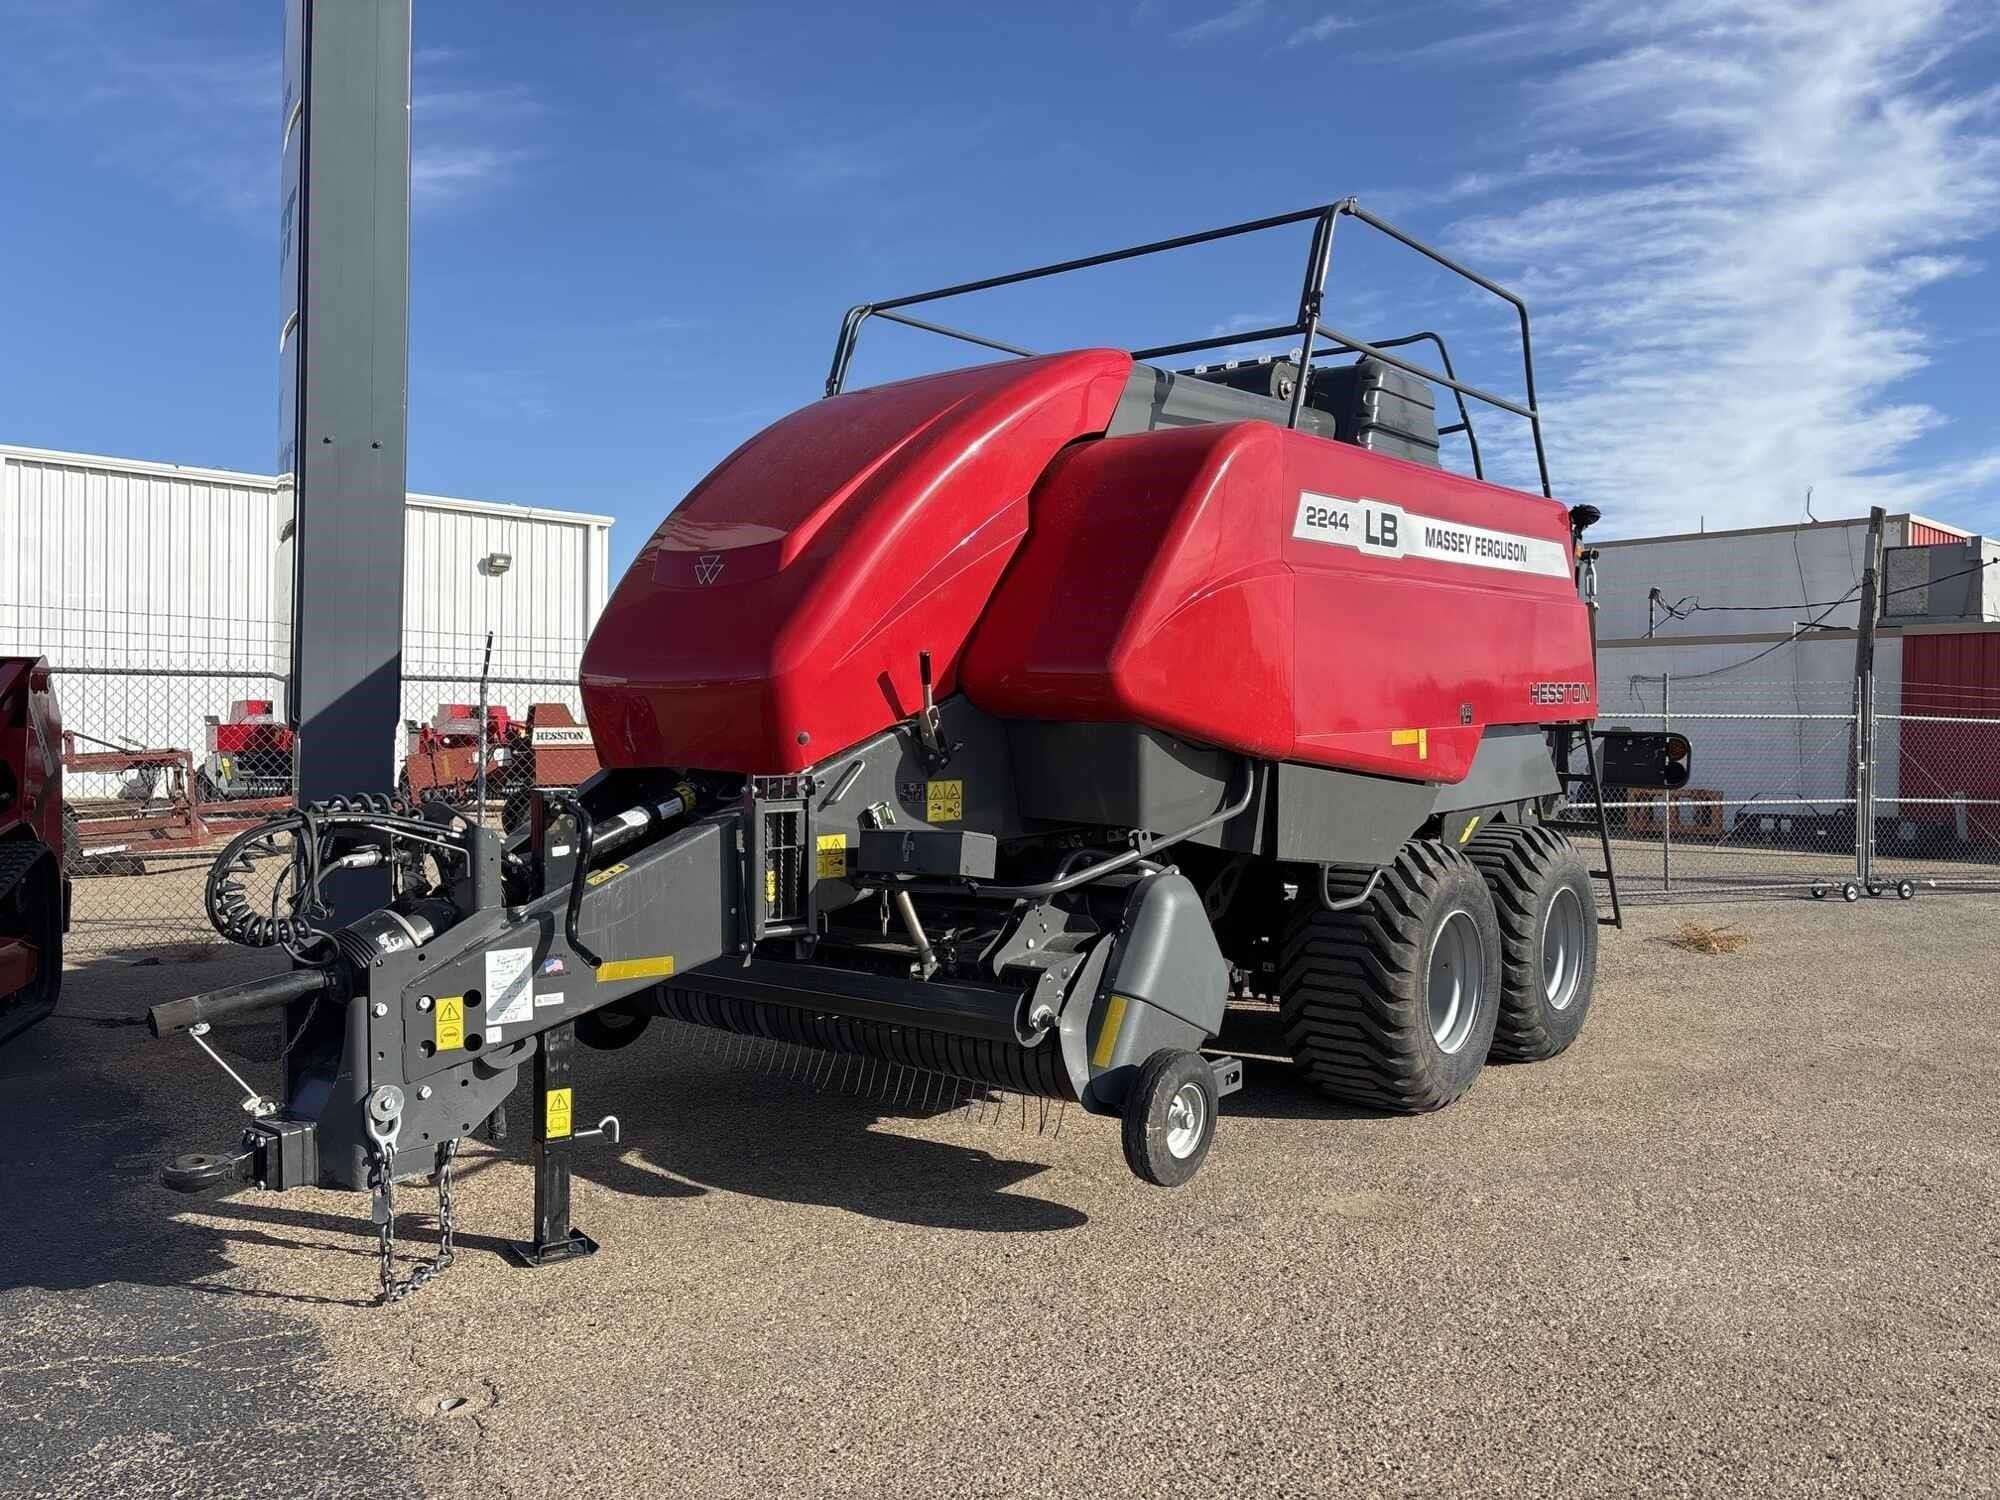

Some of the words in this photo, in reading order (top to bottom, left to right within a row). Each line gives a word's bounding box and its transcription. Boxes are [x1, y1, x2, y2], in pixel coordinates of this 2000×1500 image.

[1306, 505, 1349, 531] 2244
[1365, 509, 1398, 548] LB
[1425, 526, 1472, 554] MASSEY
[1475, 536, 1527, 562] FERGUSON
[1529, 681, 1591, 704] HESSTON
[536, 731, 584, 740] HESSTON
